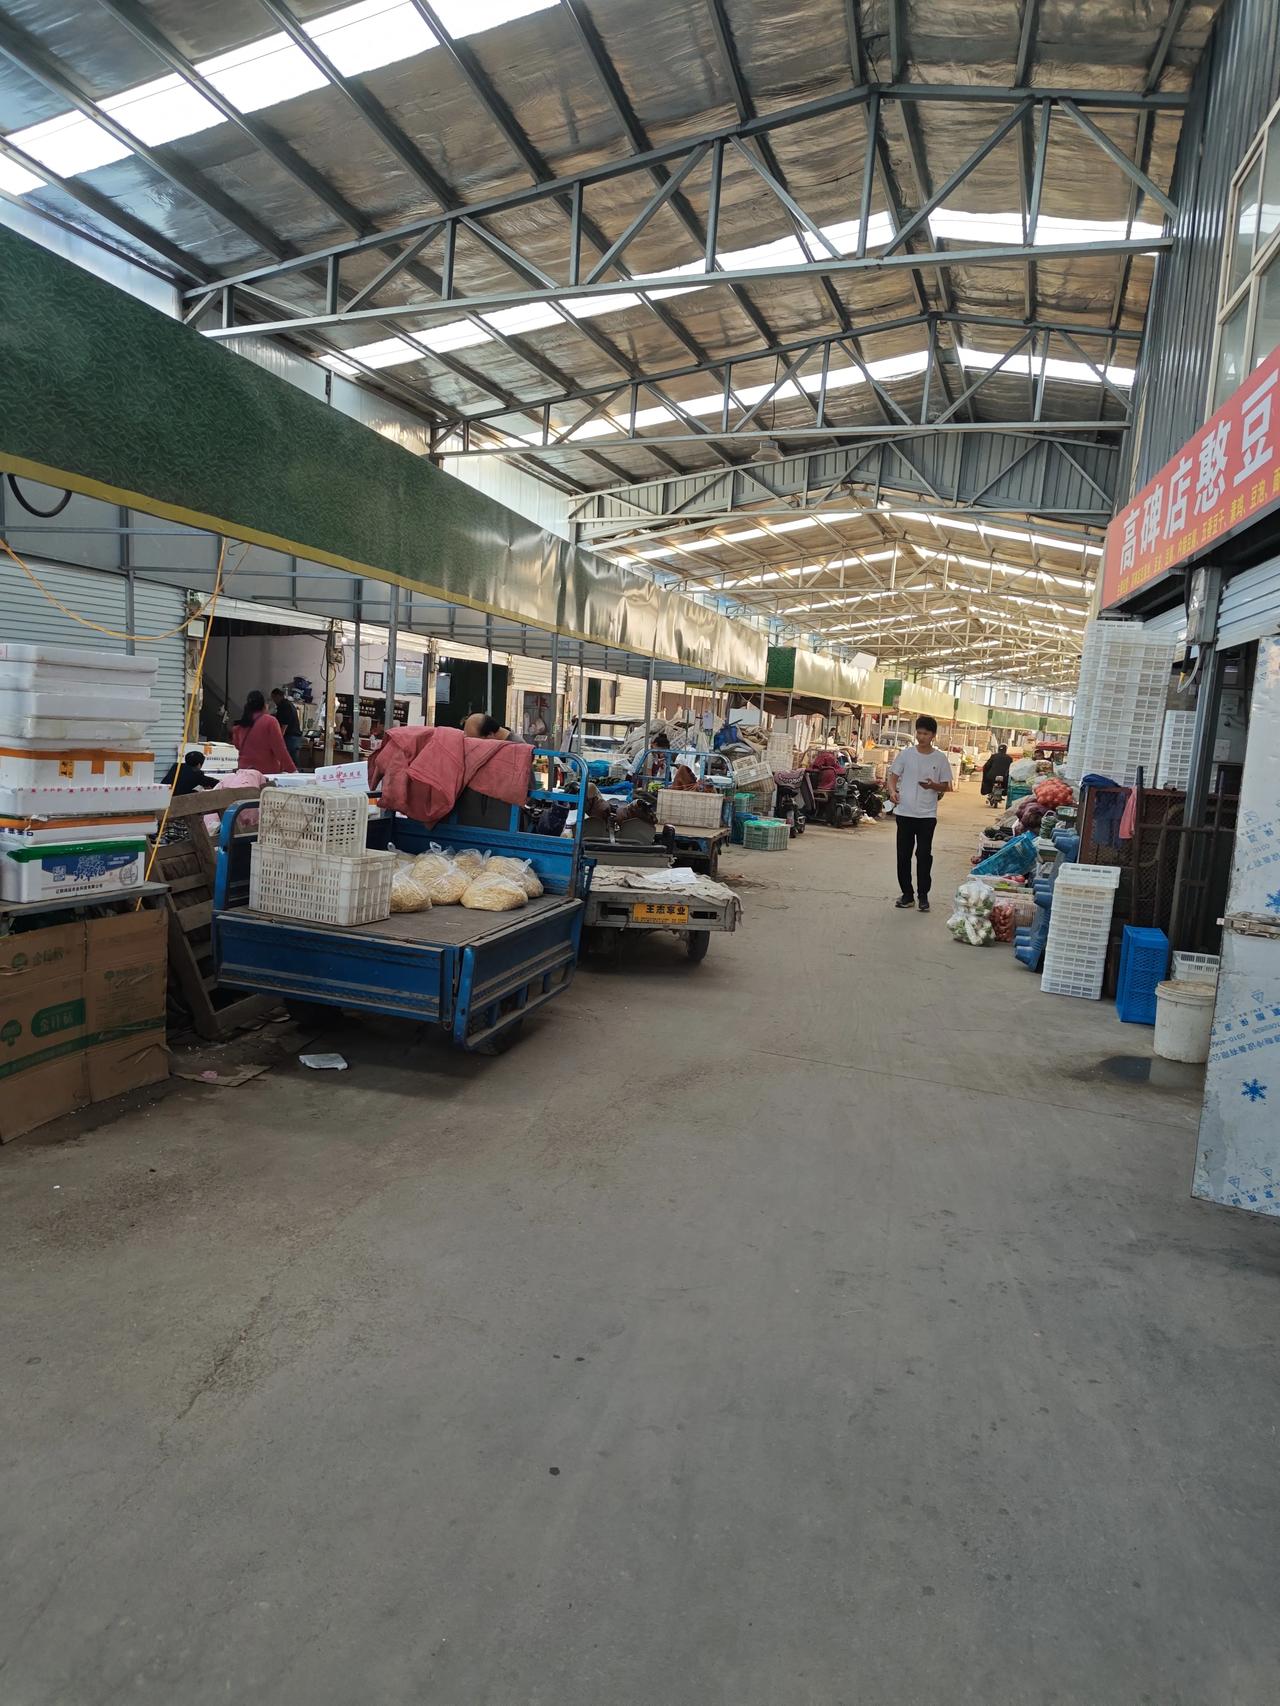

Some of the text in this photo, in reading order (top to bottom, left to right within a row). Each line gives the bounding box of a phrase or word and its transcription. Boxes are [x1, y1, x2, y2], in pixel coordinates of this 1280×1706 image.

[1120, 368, 1280, 575] 高碑店憨豆
[646, 903, 686, 916] 王杰车业
